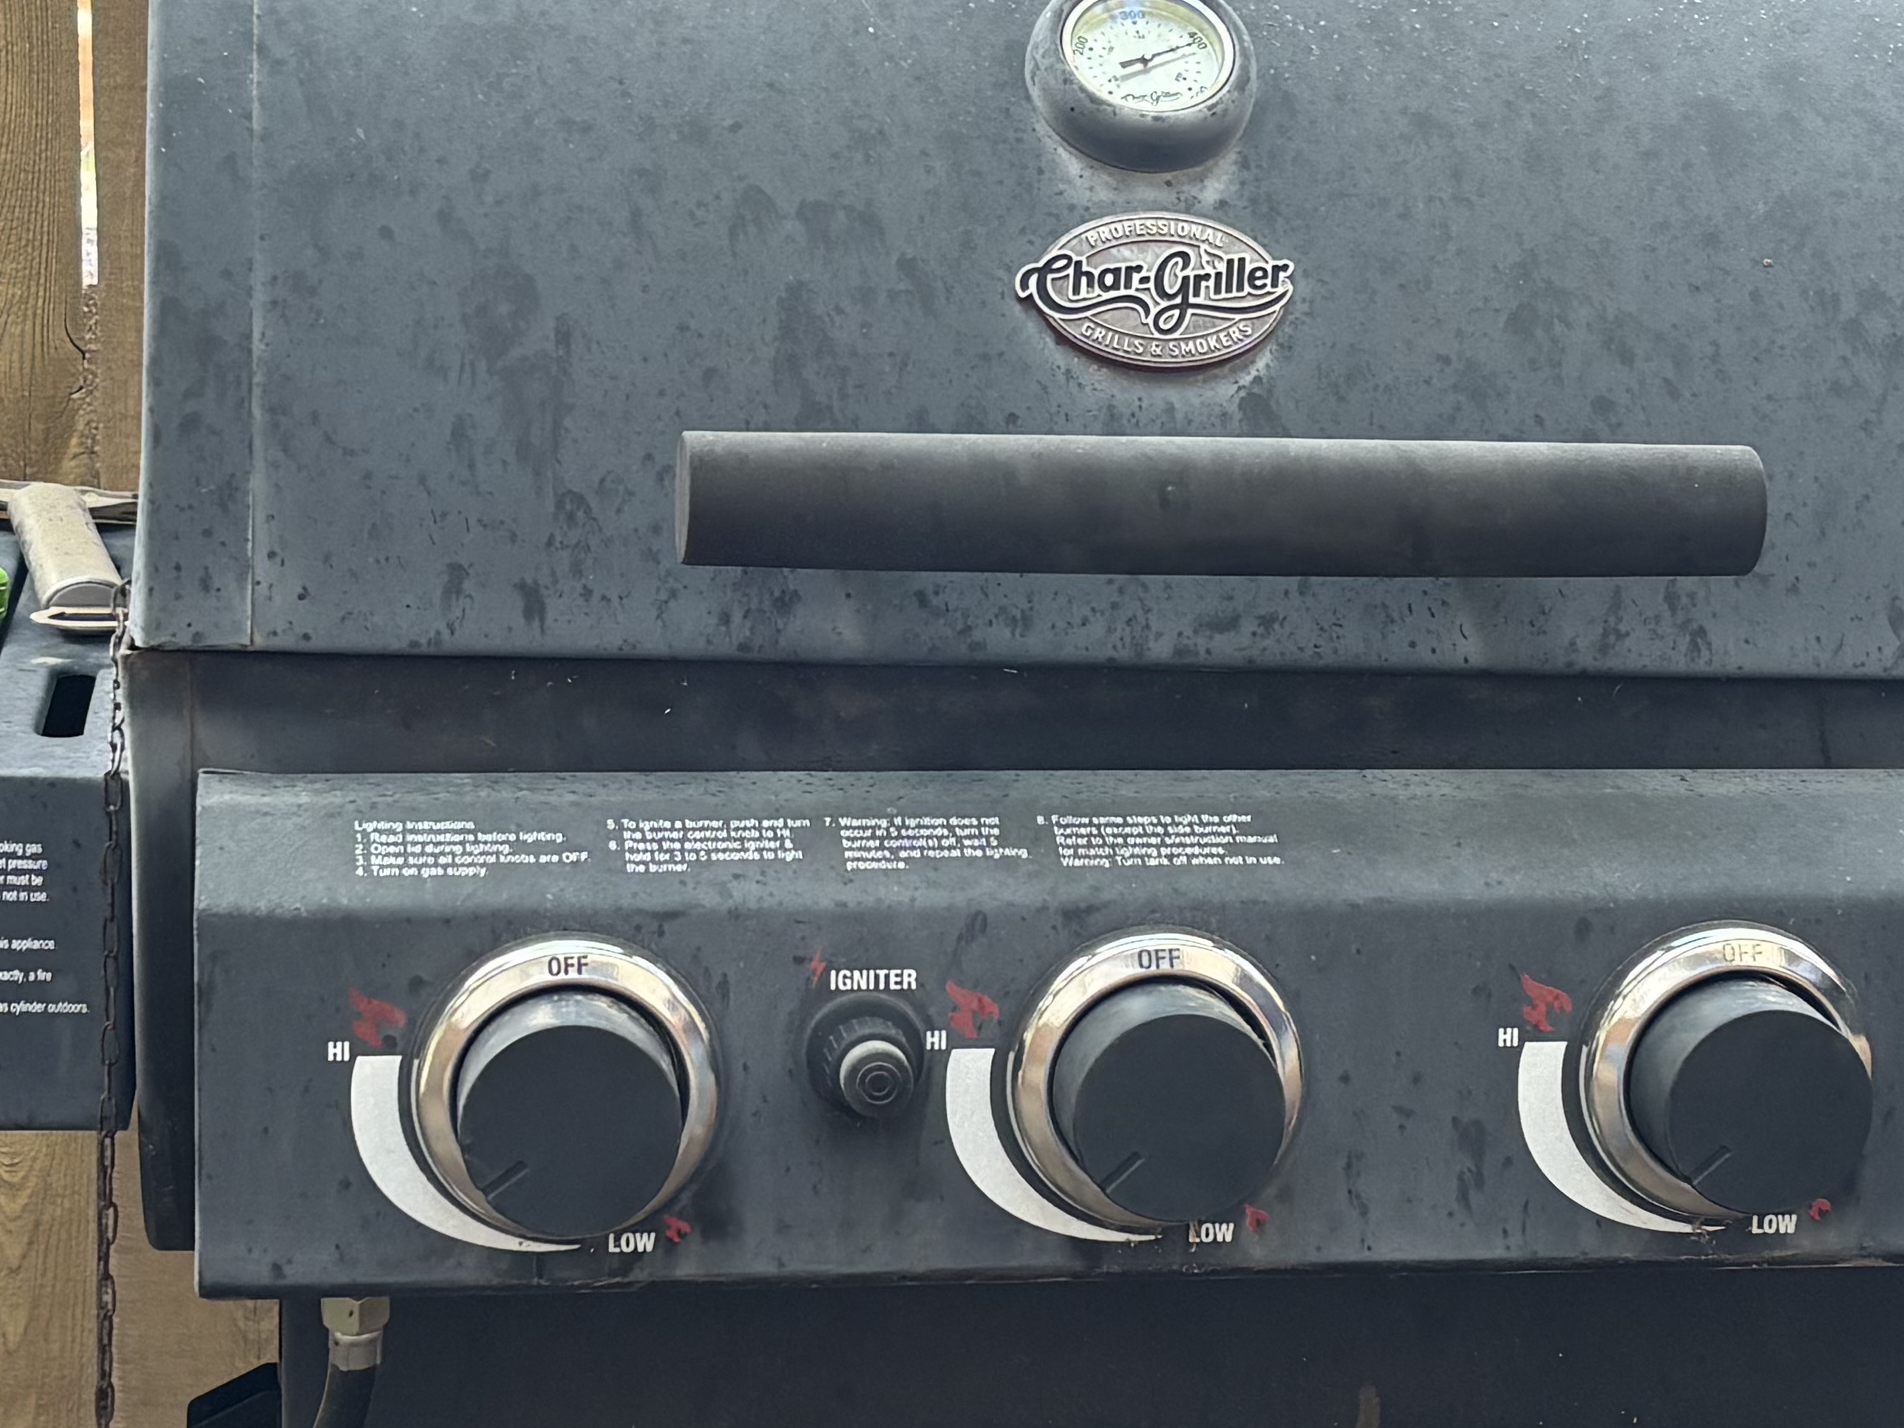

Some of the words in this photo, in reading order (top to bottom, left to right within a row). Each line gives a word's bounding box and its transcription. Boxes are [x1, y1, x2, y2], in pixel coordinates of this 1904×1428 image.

[1120, 10, 1145, 20] 300
[1073, 35, 1089, 56] 200
[1188, 31, 1207, 50] 400
[1085, 219, 1226, 247] PROFESSIONAL
[1018, 249, 1292, 337] Char-Griller
[1081, 322, 1144, 354] GRILLS
[1150, 341, 1163, 357] &
[1169, 322, 1253, 358] SMOKERS
[25, 843, 43, 857] gas
[7, 859, 48, 873] pressure
[6, 872, 29, 885] must
[31, 873, 44, 885] be
[2, 888, 17, 901] not
[19, 888, 27, 901] in
[1137, 948, 1181, 970] OFF
[1721, 942, 1764, 964] OFF
[547, 956, 588, 977] OFF
[829, 969, 917, 990] IGNITER
[926, 1031, 947, 1050] HI
[1498, 1028, 1519, 1047] HI
[327, 1041, 350, 1062] HI
[1188, 1221, 1234, 1244] LOW
[1751, 1213, 1796, 1235] LOW
[608, 1232, 656, 1253] LOW
